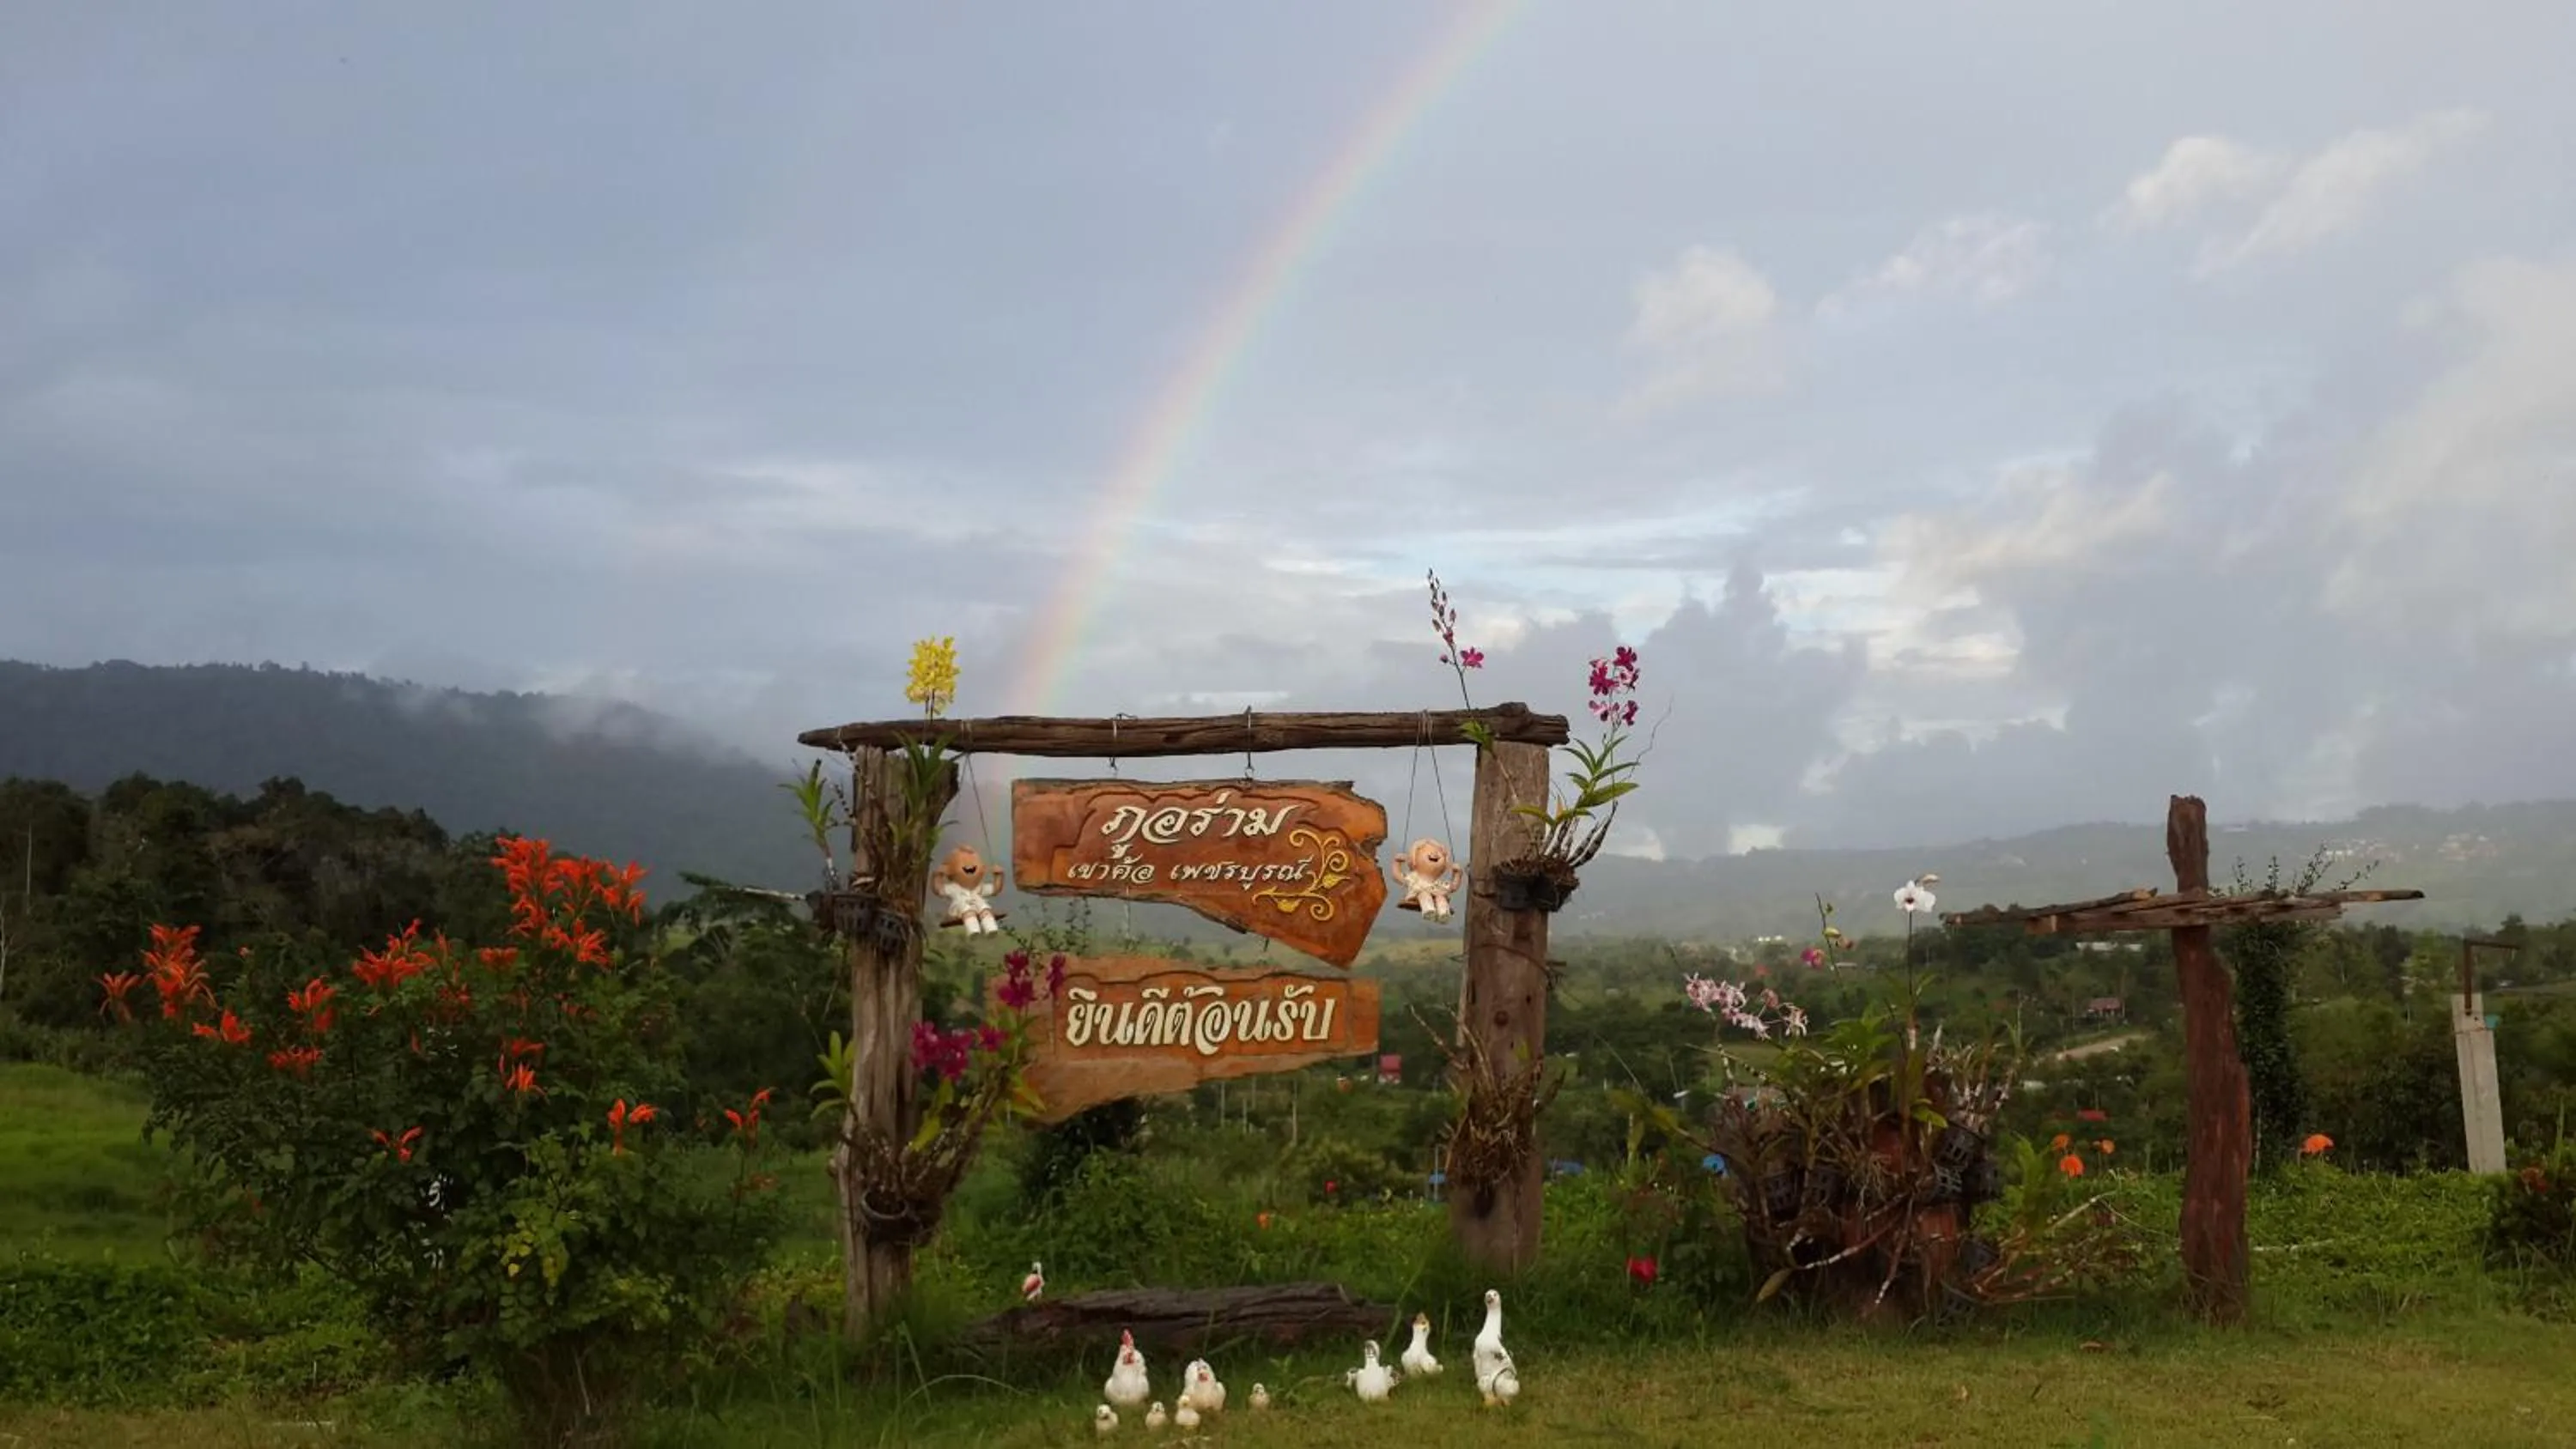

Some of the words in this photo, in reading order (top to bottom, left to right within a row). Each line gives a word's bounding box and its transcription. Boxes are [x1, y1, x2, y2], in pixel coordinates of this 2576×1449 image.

[1101, 791, 1300, 859] ภูอร่าม
[1067, 853, 1155, 883] เขาค้อ
[1170, 853, 1314, 891] เพชรบูรณ์
[1066, 985, 1336, 1055] ยินดีต้อนรับ
